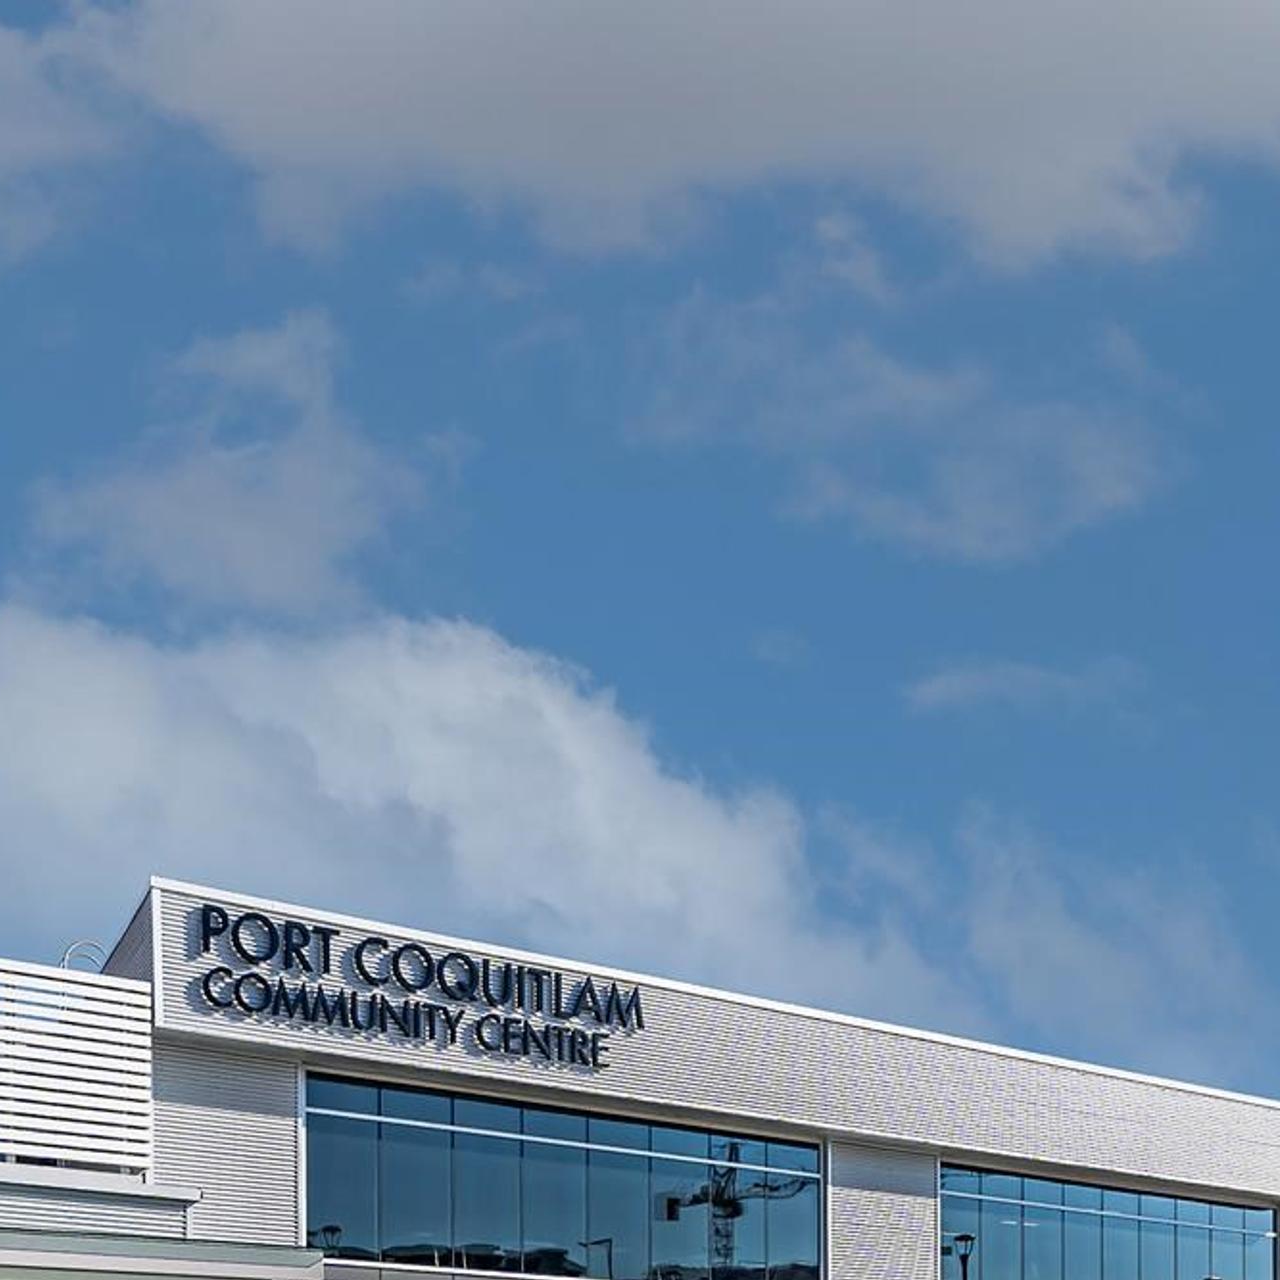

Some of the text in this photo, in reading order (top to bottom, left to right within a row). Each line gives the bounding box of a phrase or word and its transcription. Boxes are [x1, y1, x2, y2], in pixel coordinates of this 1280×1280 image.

[202, 904, 644, 1030] PORT COQUITLAM
[202, 967, 610, 1068] COMMUNITY CENTRE
